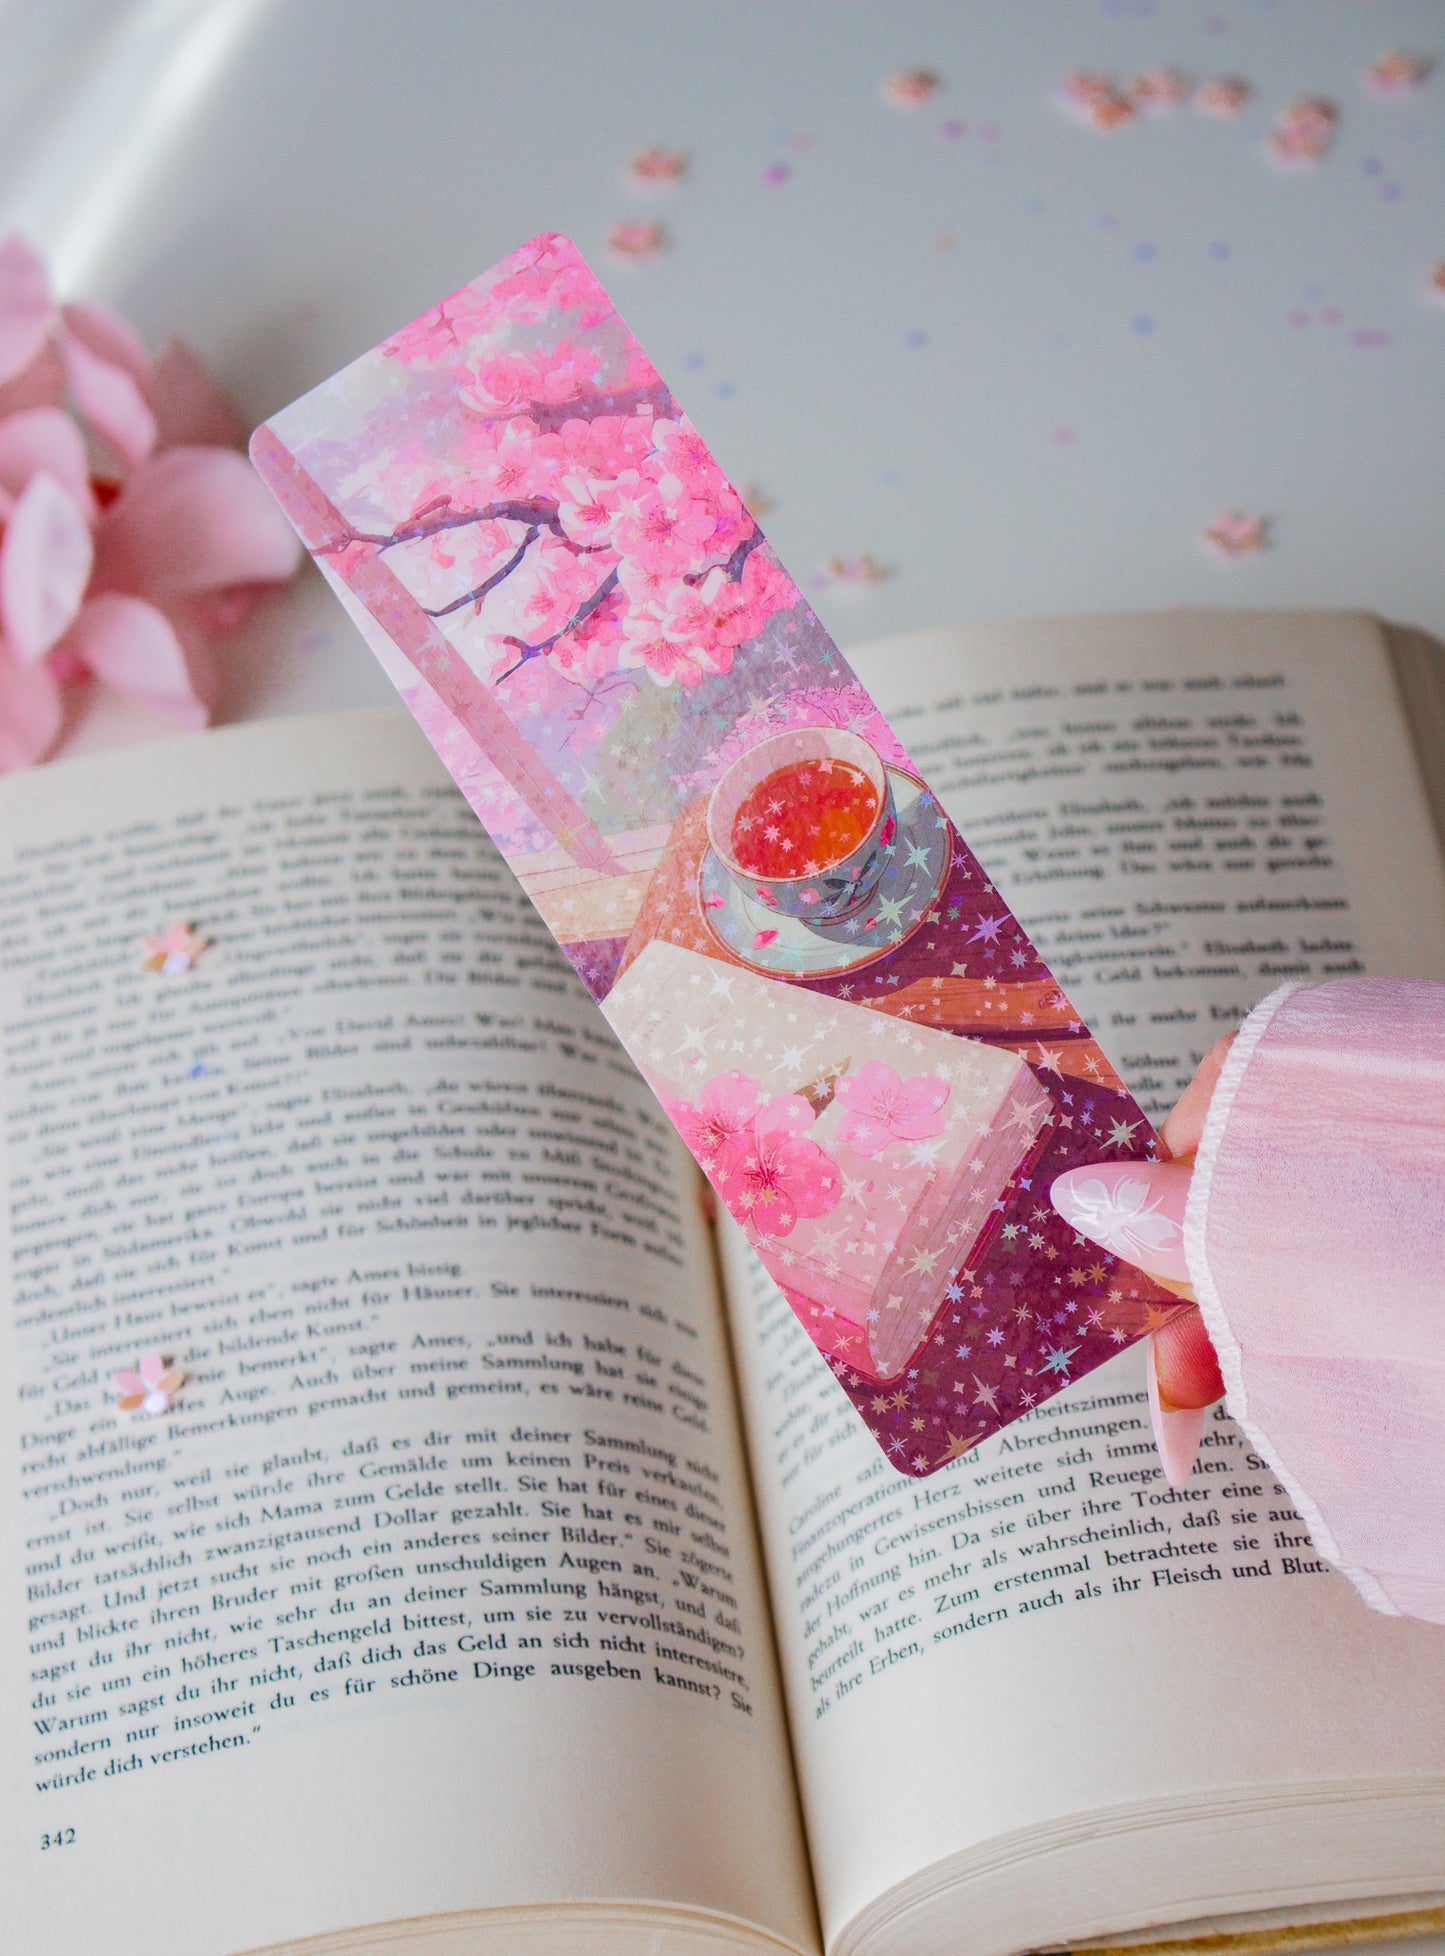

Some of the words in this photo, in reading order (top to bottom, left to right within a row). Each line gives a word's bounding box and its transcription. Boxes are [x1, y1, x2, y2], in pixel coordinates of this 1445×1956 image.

[234, 1478, 293, 1501] würde
[359, 1456, 448, 1478] Gemälde
[506, 1452, 570, 1467] keinen
[584, 1453, 630, 1474] Preis
[262, 1448, 328, 1475] glaubt,
[342, 1436, 379, 1456] daß
[510, 1426, 571, 1443] deiner
[583, 1428, 677, 1468] Sammlung
[914, 1485, 960, 1510] Herz
[974, 1462, 1042, 1486] weitete
[1057, 1448, 1092, 1467] sich
[1106, 1440, 1158, 1458] imme
[1200, 1431, 1243, 1448] ehr,
[999, 1419, 1152, 1454] Abrechnungen.
[25, 1554, 60, 1576] und
[71, 1548, 94, 1564] du
[105, 1532, 162, 1556] weißt,
[173, 1524, 205, 1540] wie
[216, 1512, 250, 1531] sich
[262, 1502, 322, 1522] Mama
[334, 1494, 374, 1509] zum
[385, 1481, 444, 1500] Gelde
[455, 1477, 507, 1494] stellt.
[518, 1476, 547, 1492] Sie
[557, 1477, 587, 1493] hat
[598, 1480, 626, 1498] für
[27, 1579, 82, 1602] Bilder
[94, 1550, 192, 1584] tatsächlich
[206, 1516, 360, 1560] zwanzigtausend
[374, 1508, 438, 1528] Dollar
[451, 1502, 528, 1524] gezahlt.
[541, 1501, 570, 1517] Sie
[582, 1503, 612, 1521] hat
[624, 1513, 642, 1526] es
[828, 1565, 901, 1616] Hoffnung
[909, 1549, 942, 1568] hin.
[952, 1532, 980, 1550] Da
[991, 1522, 1015, 1537] sie
[1026, 1510, 1070, 1528] über
[1082, 1500, 1121, 1516] ihre
[1131, 1487, 1210, 1507] Tochter
[1222, 1482, 1263, 1498] eine
[850, 1556, 864, 1571] in
[874, 1494, 1024, 1555] Gewissensbissen
[1038, 1477, 1076, 1498] und
[860, 1599, 888, 1621] war
[898, 1586, 915, 1601] es
[925, 1563, 971, 1589] mehr
[982, 1550, 1007, 1568] als
[1018, 1517, 1171, 1556] wahrscheinlich,
[1182, 1510, 1220, 1528] daß
[1232, 1509, 1257, 1524] sie
[1269, 1510, 1305, 1522] auc
[28, 1604, 92, 1632] gesagt.
[104, 1586, 145, 1608] Und
[158, 1577, 198, 1599] jetzt
[270, 1557, 295, 1572] sie
[307, 1544, 351, 1566] noch
[363, 1541, 391, 1556] ein
[404, 1532, 480, 1550] anderes
[492, 1528, 550, 1542] seiner
[644, 1537, 671, 1558] Sie
[29, 1632, 64, 1654] und
[77, 1619, 138, 1642] blickte
[150, 1605, 199, 1625] ihren
[212, 1587, 278, 1610] Bruder
[290, 1579, 320, 1595] mit
[334, 1567, 403, 1591] großen
[416, 1553, 546, 1574] unschuldigen
[560, 1552, 622, 1574] Augen
[633, 1564, 660, 1580] an.
[31, 1660, 75, 1682] sagst
[89, 1650, 112, 1667] du
[126, 1642, 152, 1658] ihr
[165, 1628, 216, 1649] nicht,
[230, 1616, 262, 1633] wie
[276, 1606, 316, 1624] sehr
[330, 1598, 354, 1614] du
[368, 1596, 390, 1608] an
[404, 1586, 467, 1603] deiner
[480, 1578, 587, 1599] Sammlung
[598, 1580, 664, 1608] hängst,
[876, 1614, 922, 1642] hatte.
[936, 1589, 979, 1614] Zum
[994, 1555, 1090, 1592] erstenmal
[1104, 1542, 1218, 1566] betrachtete
[1233, 1535, 1259, 1551] sie
[1274, 1532, 1314, 1548] ihre
[32, 1692, 55, 1709] du
[67, 1685, 91, 1700] sie
[102, 1676, 130, 1692] um
[143, 1666, 170, 1682] ein
[182, 1648, 257, 1672] höheres
[268, 1618, 391, 1653] Taschengeld
[403, 1613, 471, 1630] bittest,
[484, 1611, 514, 1623] um
[526, 1606, 552, 1621] sie
[564, 1610, 587, 1621] zu
[34, 1710, 107, 1735] Warum
[119, 1695, 164, 1716] sagst
[176, 1685, 199, 1702] du
[212, 1678, 238, 1694] ihr
[250, 1665, 302, 1686] nicht,
[314, 1652, 351, 1672] daß
[362, 1644, 402, 1664] dich
[414, 1640, 446, 1656] das
[458, 1634, 506, 1651] Geld
[518, 1638, 542, 1648] an
[553, 1632, 589, 1648] sich
[600, 1636, 646, 1654] nicht
[656, 1642, 749, 1692] interessiere,
[816, 1698, 830, 1720] als
[836, 1674, 862, 1699] ihre
[871, 1643, 924, 1675] Erben,
[934, 1609, 1008, 1643] sondern
[1019, 1590, 1064, 1613] auch
[1075, 1582, 1102, 1600] als
[1113, 1576, 1141, 1592] ihr
[1152, 1564, 1222, 1586] Fleisch
[1232, 1560, 1272, 1578] und
[1282, 1558, 1334, 1574] Blut.
[34, 1738, 110, 1765] sondern
[126, 1726, 159, 1742] nur
[174, 1703, 254, 1731] insoweit
[270, 1693, 294, 1709] du
[310, 1689, 329, 1702] es
[345, 1678, 375, 1696] für
[391, 1669, 458, 1688] schöne
[474, 1662, 535, 1681] Dinge
[551, 1660, 641, 1680] ausgeben
[654, 1667, 720, 1700] kannst?
[731, 1692, 753, 1716] Sie
[36, 1767, 96, 1792] würde
[104, 1754, 142, 1776] dich
[41, 1828, 75, 1850] 342
